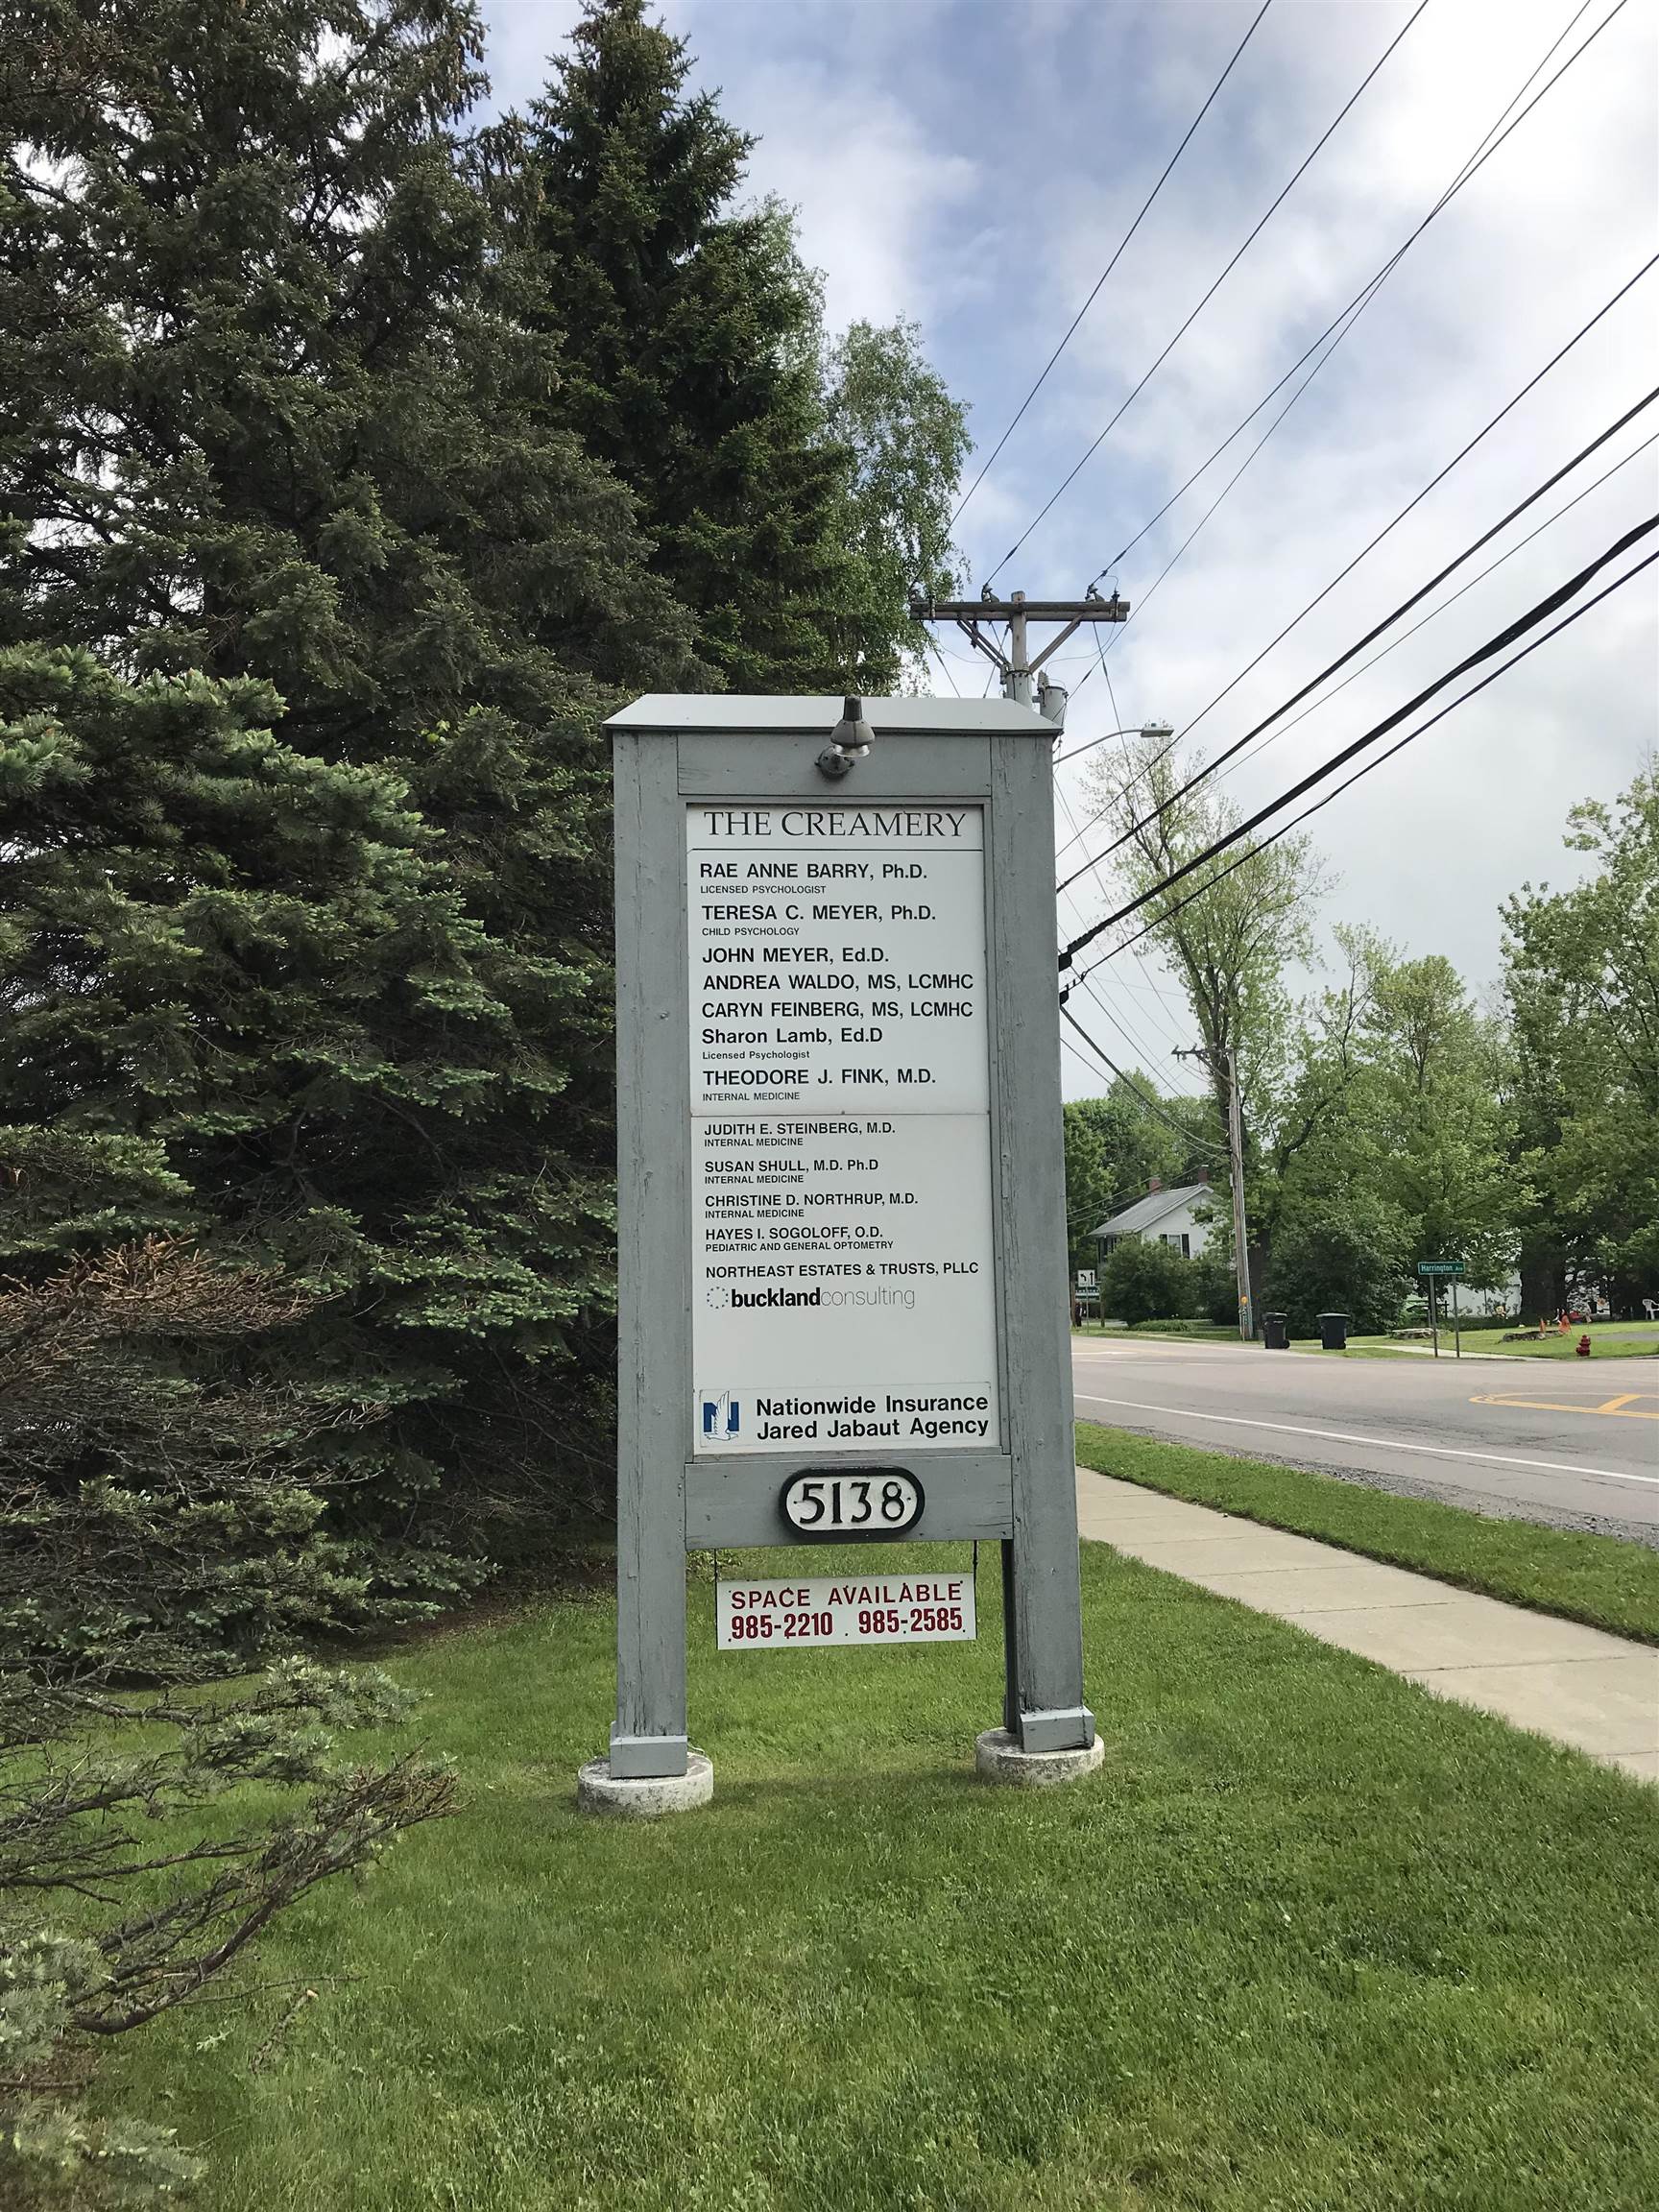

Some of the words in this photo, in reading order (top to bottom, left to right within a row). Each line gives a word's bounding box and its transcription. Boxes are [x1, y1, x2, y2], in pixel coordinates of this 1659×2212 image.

[704, 812, 771, 835] THE
[781, 811, 966, 837] CREAMERY
[701, 863, 737, 878] RAE
[747, 863, 798, 878] ANNE
[807, 864, 873, 880] BARRY,
[883, 864, 926, 878] Ph.D.
[702, 905, 777, 920] TERESA
[785, 905, 804, 920] C.
[813, 905, 882, 922] MEYER,
[892, 905, 935, 920] Ph.D.
[703, 948, 754, 963] JOHN
[763, 948, 833, 965] MEYER,
[843, 948, 888, 962] Ed.D.
[704, 975, 781, 990] ANDREA
[788, 974, 858, 992] WALDO,
[868, 974, 901, 992] MS,
[909, 974, 974, 989] LCMHC
[703, 1002, 762, 1018] CARYN
[772, 1001, 863, 1019] FEINBERG,
[873, 1001, 902, 1019] MS,
[911, 1002, 973, 1017] LCMHC
[702, 1029, 767, 1044] Sharon
[777, 1028, 831, 1045] Lamb,
[841, 1027, 882, 1042] Ed.D
[750, 1050, 809, 1060] Psychologist
[703, 1070, 808, 1085] THEODORE
[818, 1070, 832, 1084] J.
[842, 1069, 888, 1086] FINK,
[898, 1069, 935, 1083] M.D.
[705, 1123, 755, 1135] JUDITH
[760, 1123, 772, 1134] E.
[777, 1122, 862, 1135] STEINBERG,
[867, 1122, 895, 1133] M.D.
[705, 1161, 754, 1172] SUSAN
[758, 1161, 808, 1173] SHULL,
[814, 1160, 842, 1170] M.D.
[848, 1160, 878, 1170] Ph.D
[706, 1195, 781, 1207] CHRISTINE
[786, 1194, 799, 1205] D.
[805, 1193, 884, 1206] NORTHRUP,
[890, 1193, 918, 1204] M.D.
[707, 1228, 753, 1239] HAYES
[757, 1229, 764, 1238] I.
[769, 1227, 850, 1239] SOGOLOFF,
[855, 1226, 882, 1238] O.D.
[706, 1243, 757, 1252] PEDIATRIC
[707, 1265, 794, 1278] NORTHEAST
[800, 1264, 861, 1276] ESTATES
[866, 1264, 875, 1275] &
[879, 1262, 938, 1276] TRUSTS,
[944, 1262, 978, 1273] PLLC
[1421, 1264, 1453, 1273] Harrington
[757, 1396, 876, 1416] Nationwide
[886, 1395, 988, 1412] Insurance
[757, 1421, 817, 1439] Jared
[828, 1419, 900, 1437] Jabaut
[910, 1418, 988, 1438] Agency
[800, 1481, 904, 1525] 5138
[732, 1587, 810, 1609] SPACE
[828, 1581, 963, 1605] AVAILABLE
[732, 1612, 832, 1639] 985-2210
[859, 1607, 962, 1634] 985-2585
